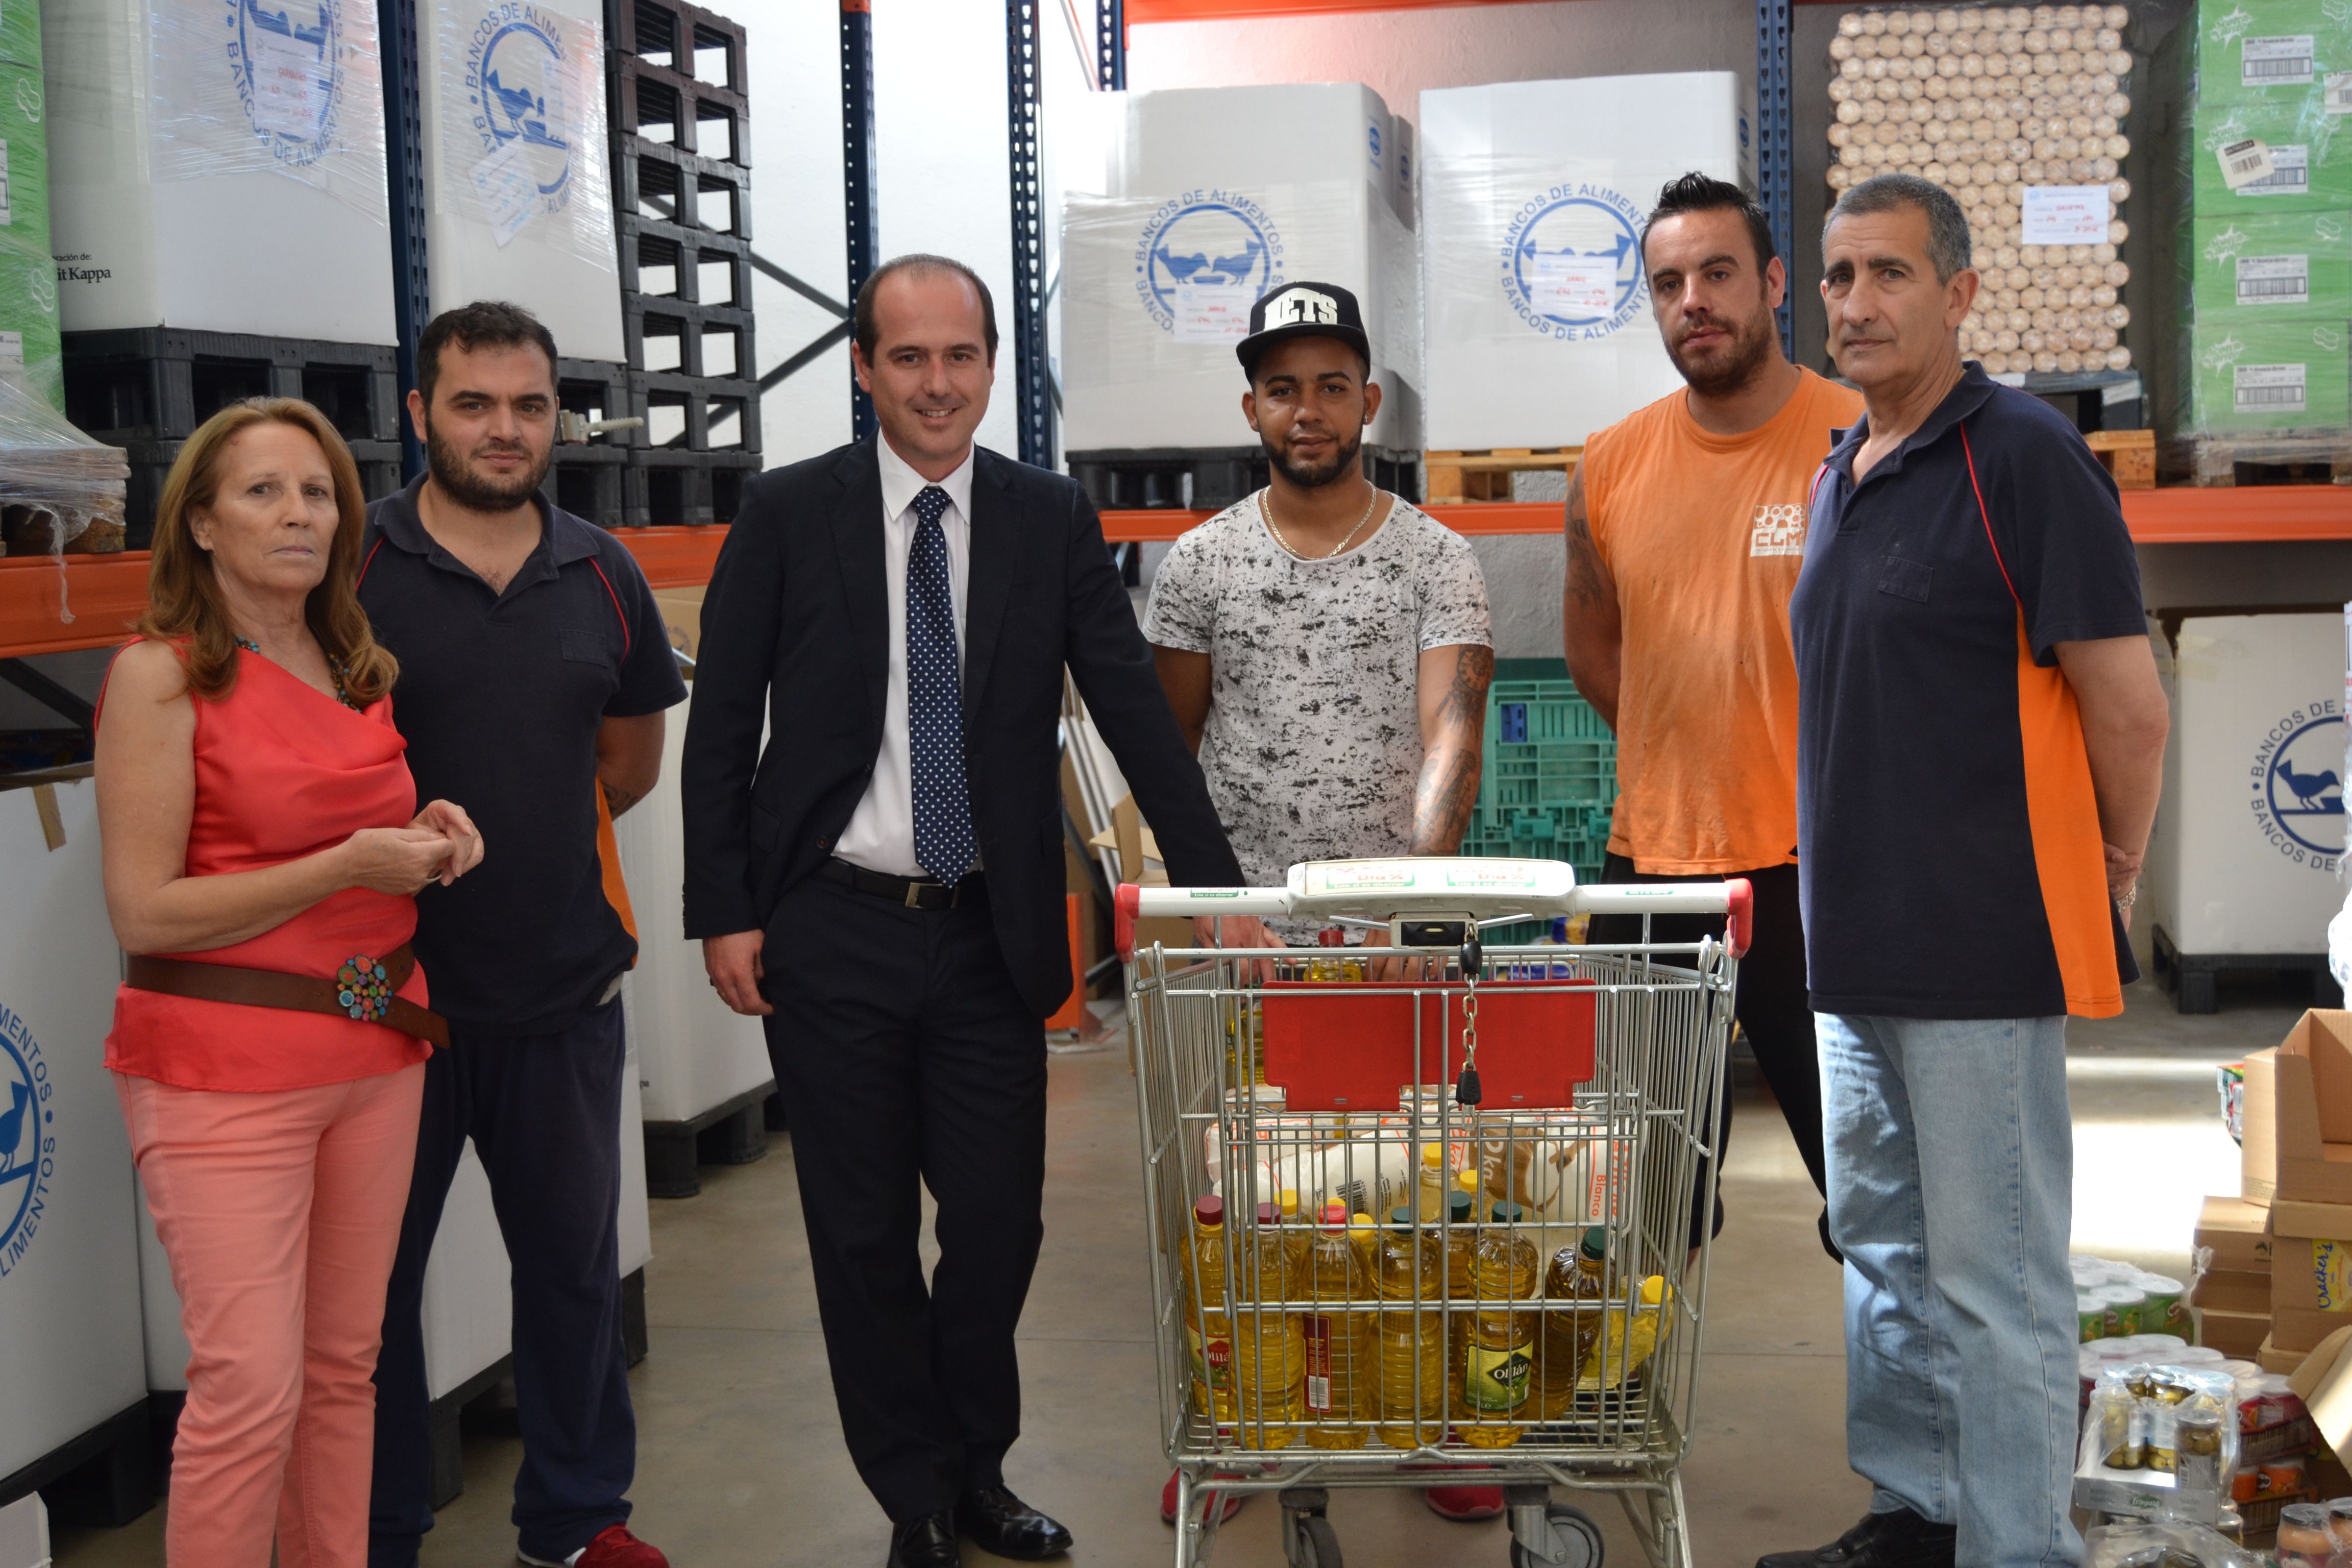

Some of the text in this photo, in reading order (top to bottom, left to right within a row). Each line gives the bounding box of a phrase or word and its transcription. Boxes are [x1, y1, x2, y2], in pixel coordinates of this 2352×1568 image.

[466, 11, 499, 88] BANCOS
[501, 3, 519, 20] DE
[274, 139, 291, 165] DE
[1136, 189, 1283, 261] BANCOS DE ALIMENTOS
[1502, 183, 1648, 256] BANCOS DE ALIMENT
[68, 267, 111, 284] Kappa
[1136, 280, 1174, 334] BANCO
[1502, 276, 1650, 341] BANCOS DE ALIMENTO
[1755, 532, 1801, 547] CLM
[2251, 700, 2336, 777] BANCOS DE
[2251, 799, 2336, 872] BANCOS DE
[0, 1136, 55, 1276] LIMENTOS
[1592, 1174, 1607, 1216] Blanco
[2315, 1242, 2333, 1309] Cracker's
[1208, 1352, 1229, 1362] lilá
[1494, 1363, 1528, 1379] Ollán
